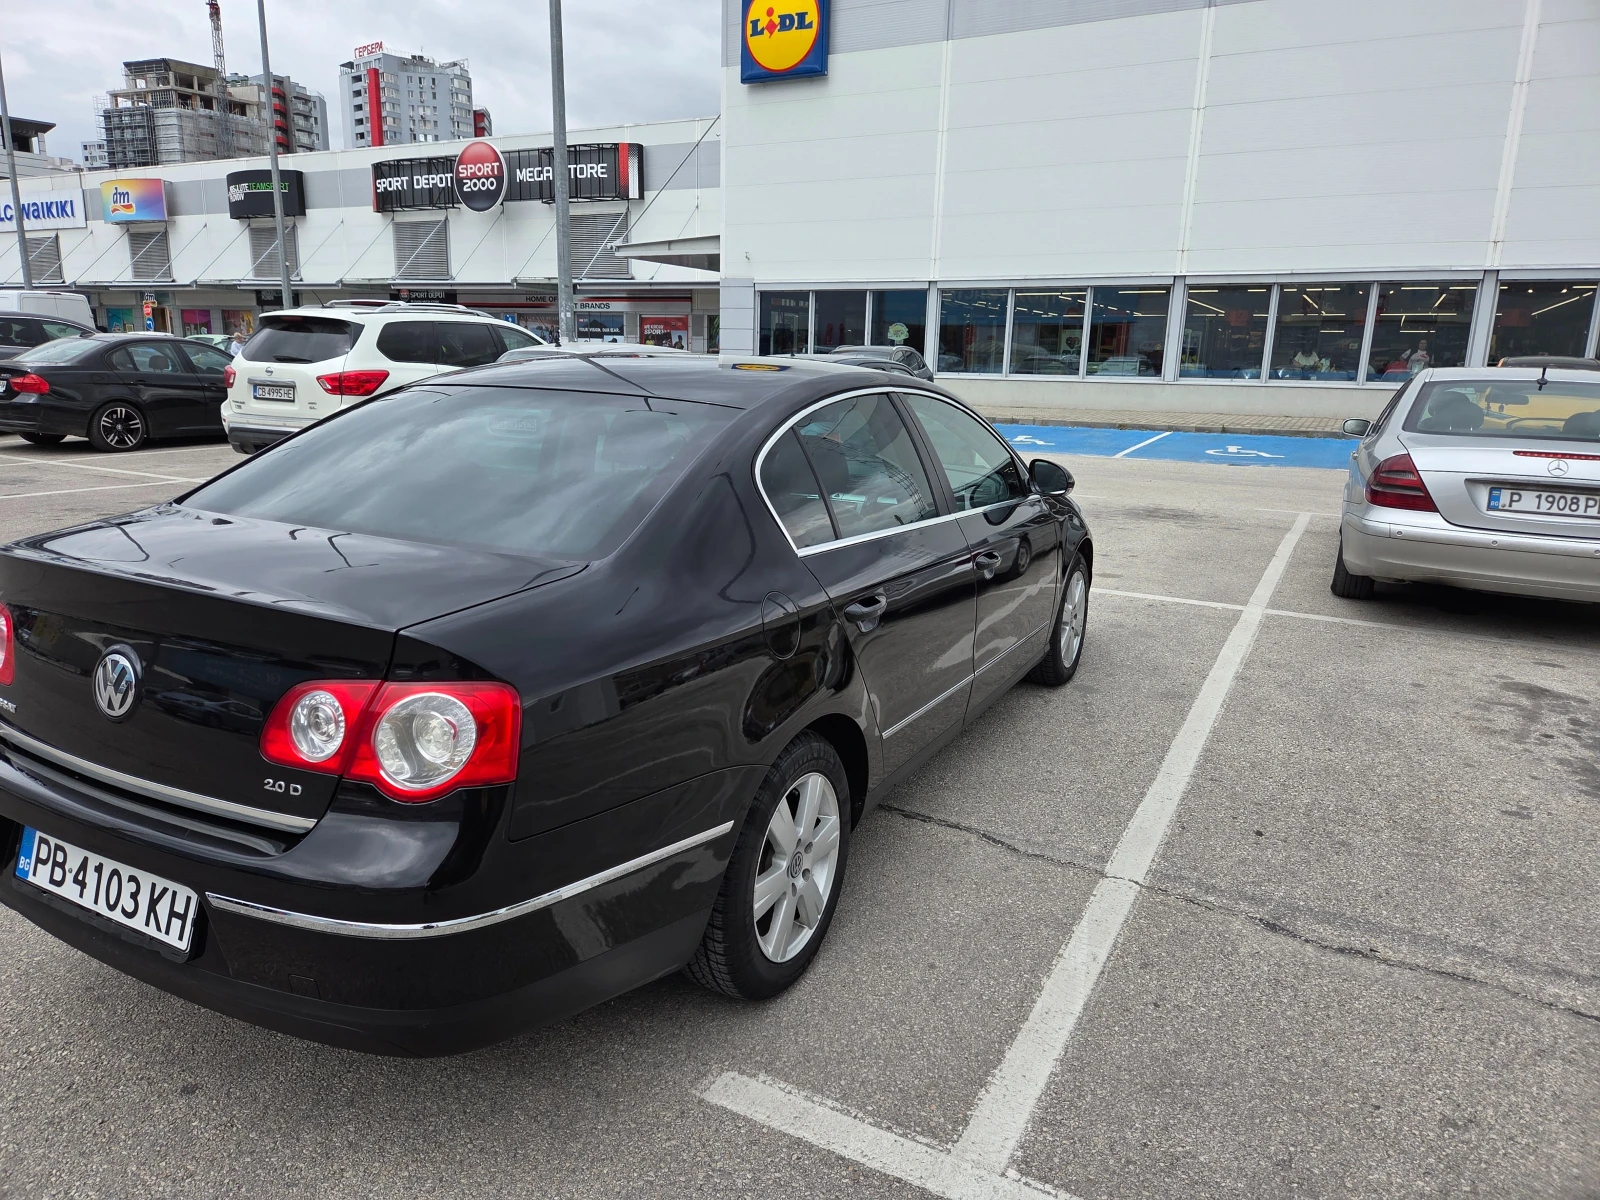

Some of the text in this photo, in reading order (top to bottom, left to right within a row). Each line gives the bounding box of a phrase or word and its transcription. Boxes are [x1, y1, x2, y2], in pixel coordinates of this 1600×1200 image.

[749, 7, 814, 38] LIDL
[354, 41, 384, 59] ГЕРБЕРА
[376, 163, 608, 193] SPORT DEPOT MEGA TORE
[458, 162, 500, 177] SPORT
[249, 182, 290, 191] TEAMSPRT
[463, 178, 497, 192] 2000
[112, 187, 130, 204] dm
[257, 387, 293, 398] CB 4995 HE
[1508, 492, 1523, 507] P
[1535, 493, 1580, 512] 1908
[1583, 497, 1600, 515] P
[289, 783, 302, 796] D
[18, 835, 192, 942] BG PB 4103 KH
